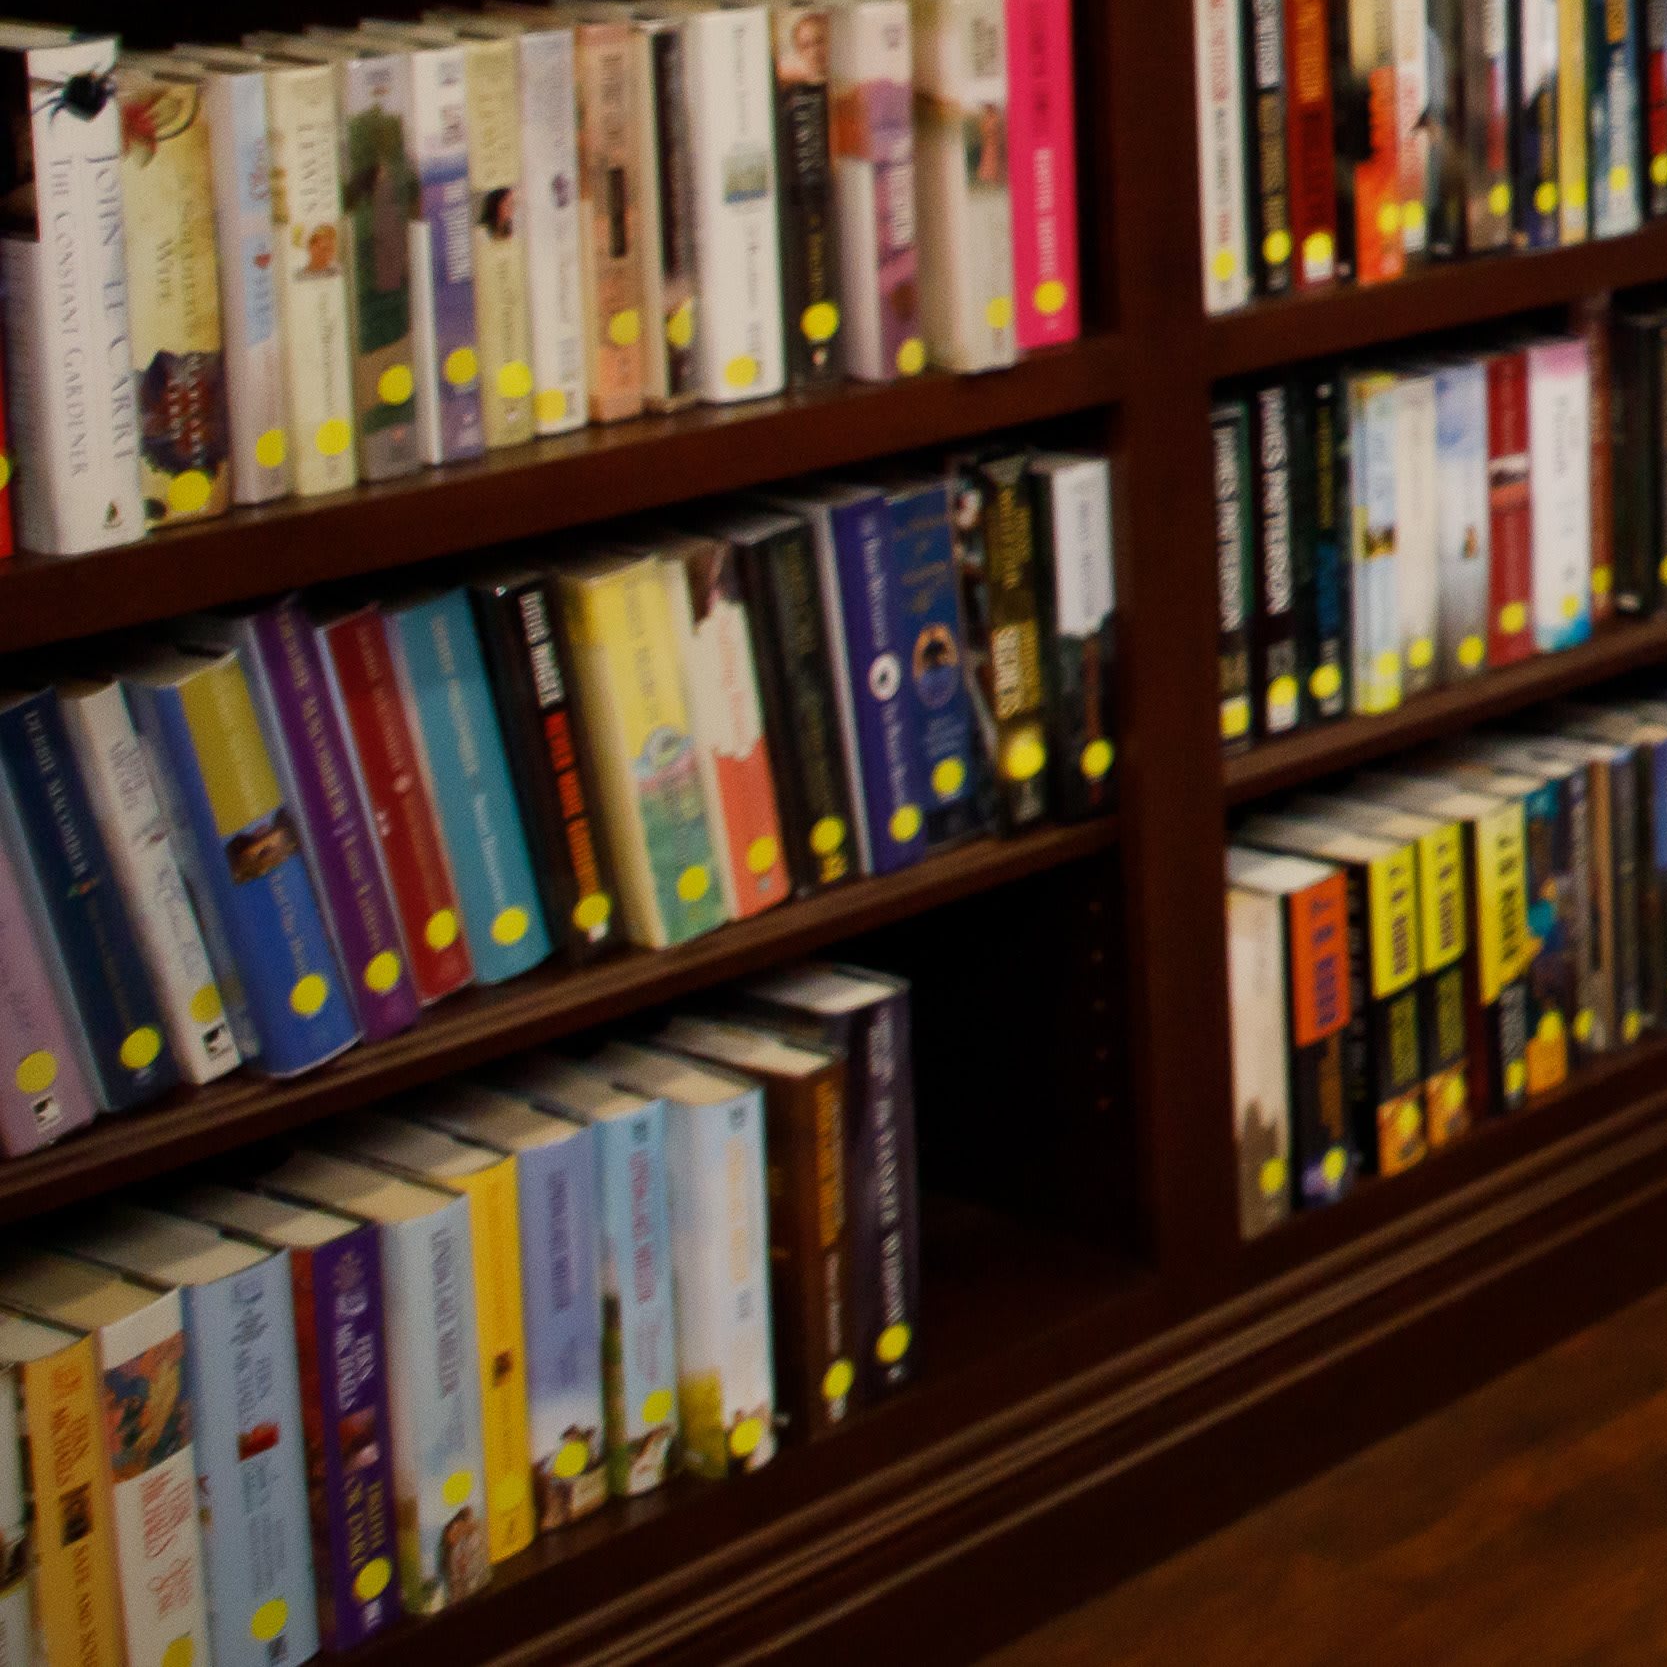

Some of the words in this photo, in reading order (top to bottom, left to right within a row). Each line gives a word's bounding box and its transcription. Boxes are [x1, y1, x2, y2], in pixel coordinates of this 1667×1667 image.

[50, 156, 73, 196] THE
[55, 215, 83, 337] CONSTANT
[65, 348, 90, 479] GARDENER
[1257, 387, 1288, 470] JAMES
[1213, 425, 1238, 501] JAMES
[1216, 500, 1243, 633] PATTERSON
[1262, 469, 1293, 616] PATTERSON
[24, 708, 60, 772] DEBBIE
[47, 778, 90, 879] MACOMBER
[337, 1321, 360, 1411] MICHAELS
[355, 1325, 375, 1384] FERN
[52, 1404, 81, 1490] MICHAELS
[76, 1413, 93, 1471] FERN
[142, 1469, 178, 1561] MICHAELS
